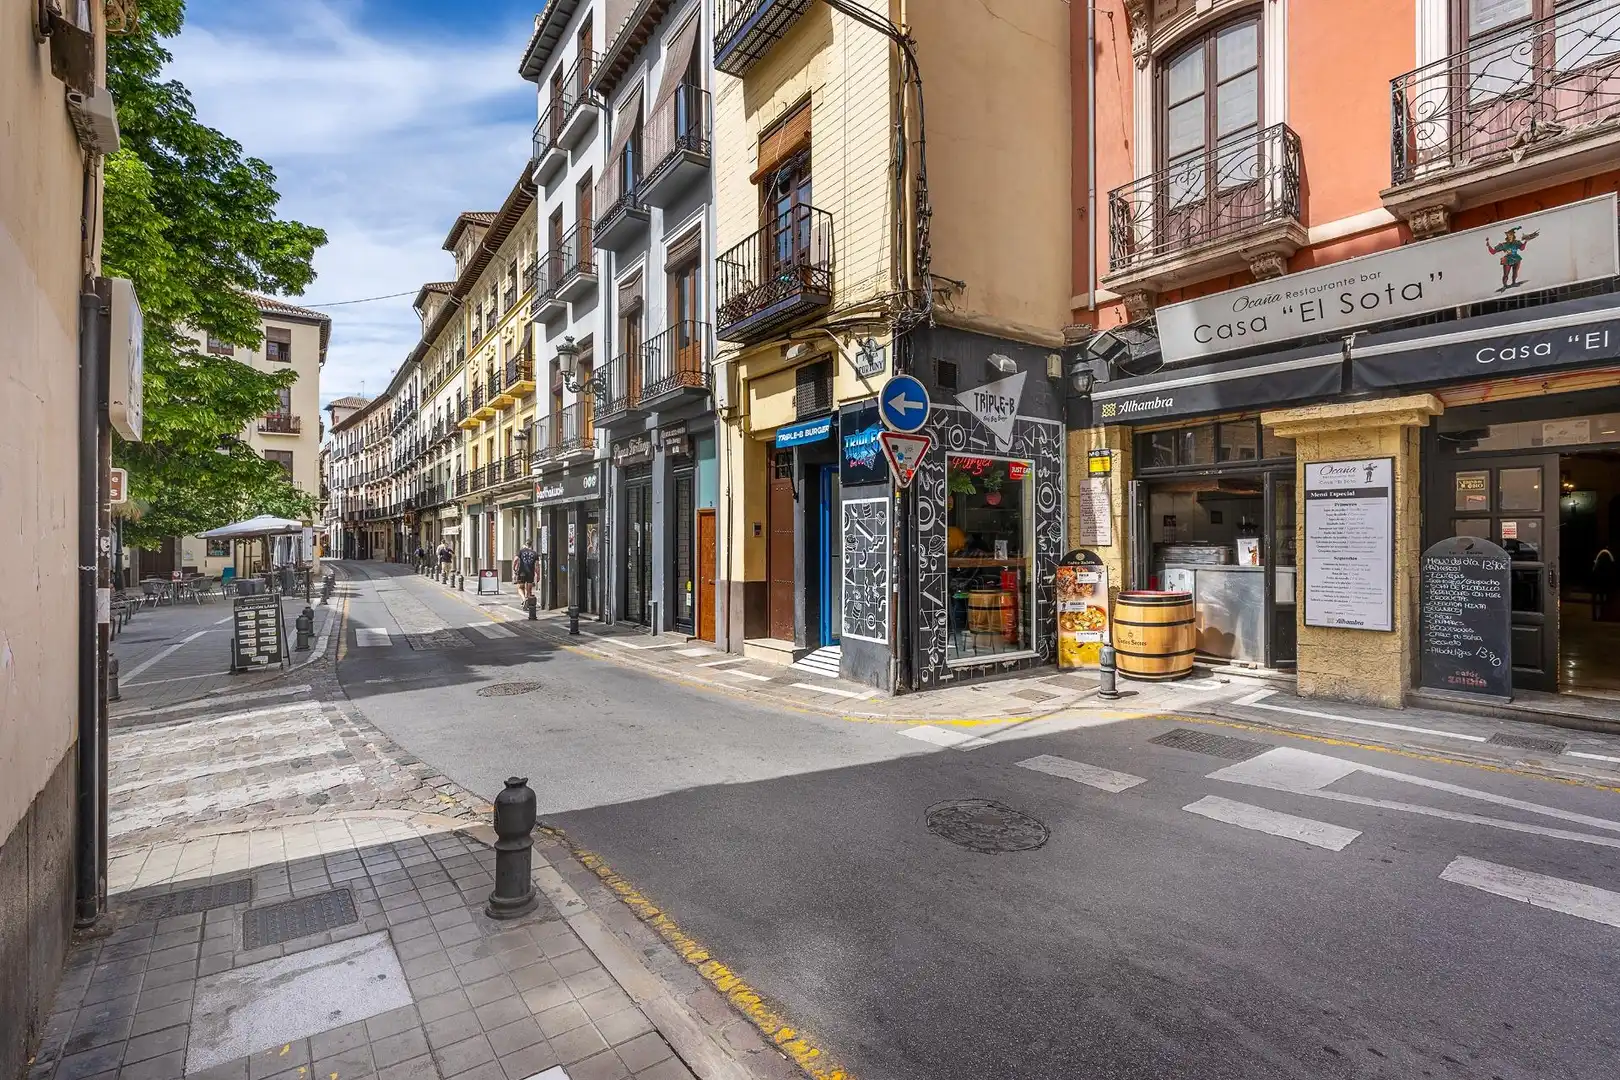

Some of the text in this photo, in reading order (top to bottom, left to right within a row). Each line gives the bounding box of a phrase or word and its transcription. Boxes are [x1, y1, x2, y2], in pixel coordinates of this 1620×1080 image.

[1232, 271, 1382, 313] Ocaña Restaurante bar
[1193, 271, 1443, 344] Casa "El Sota"
[1476, 330, 1608, 364] Casa "El
[974, 389, 1015, 416] TRIPLE-B
[1118, 396, 1174, 415] Alhambra
[778, 424, 830, 442] TRIPLE-B BURGER
[1336, 618, 1364, 626] Alhambra
